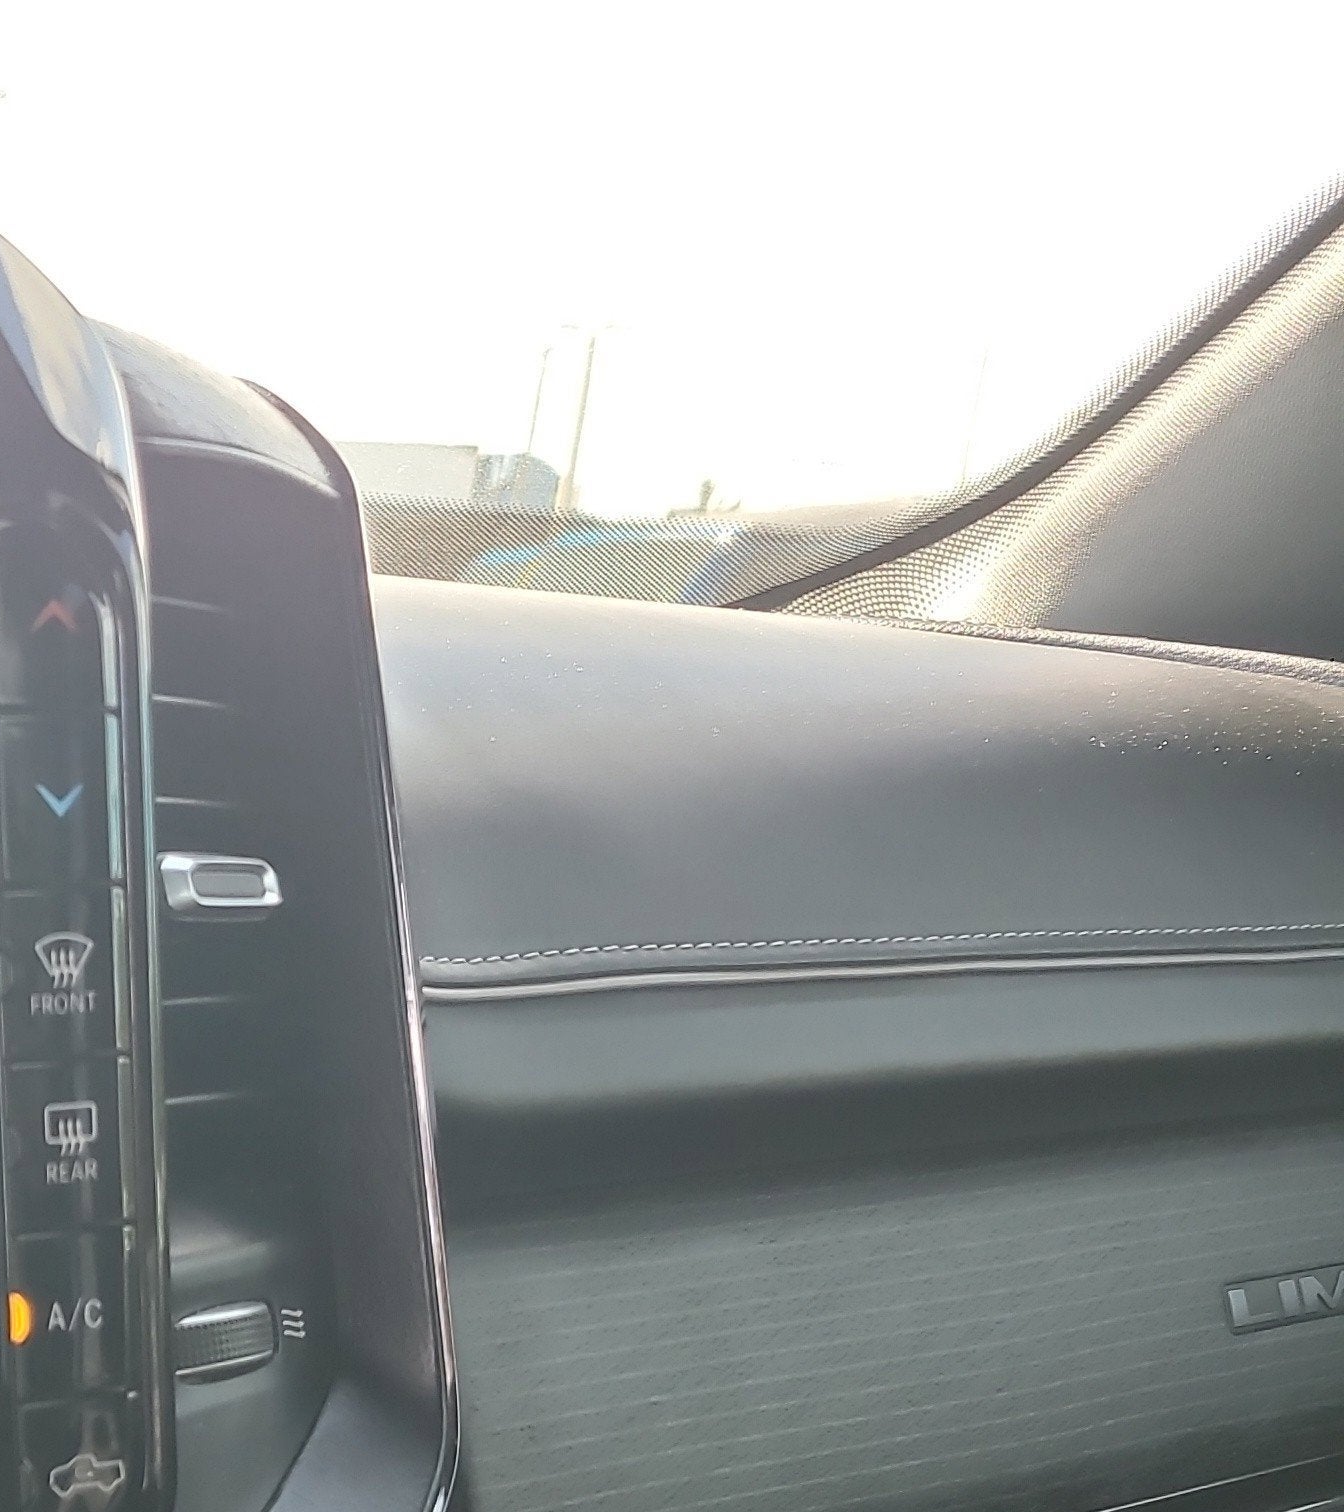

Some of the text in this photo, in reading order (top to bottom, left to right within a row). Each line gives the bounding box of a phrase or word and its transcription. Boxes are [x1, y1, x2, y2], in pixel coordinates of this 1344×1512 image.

[30, 990, 96, 1015] FRONT
[46, 1158, 98, 1184] REAR
[48, 1298, 102, 1331] A/C
